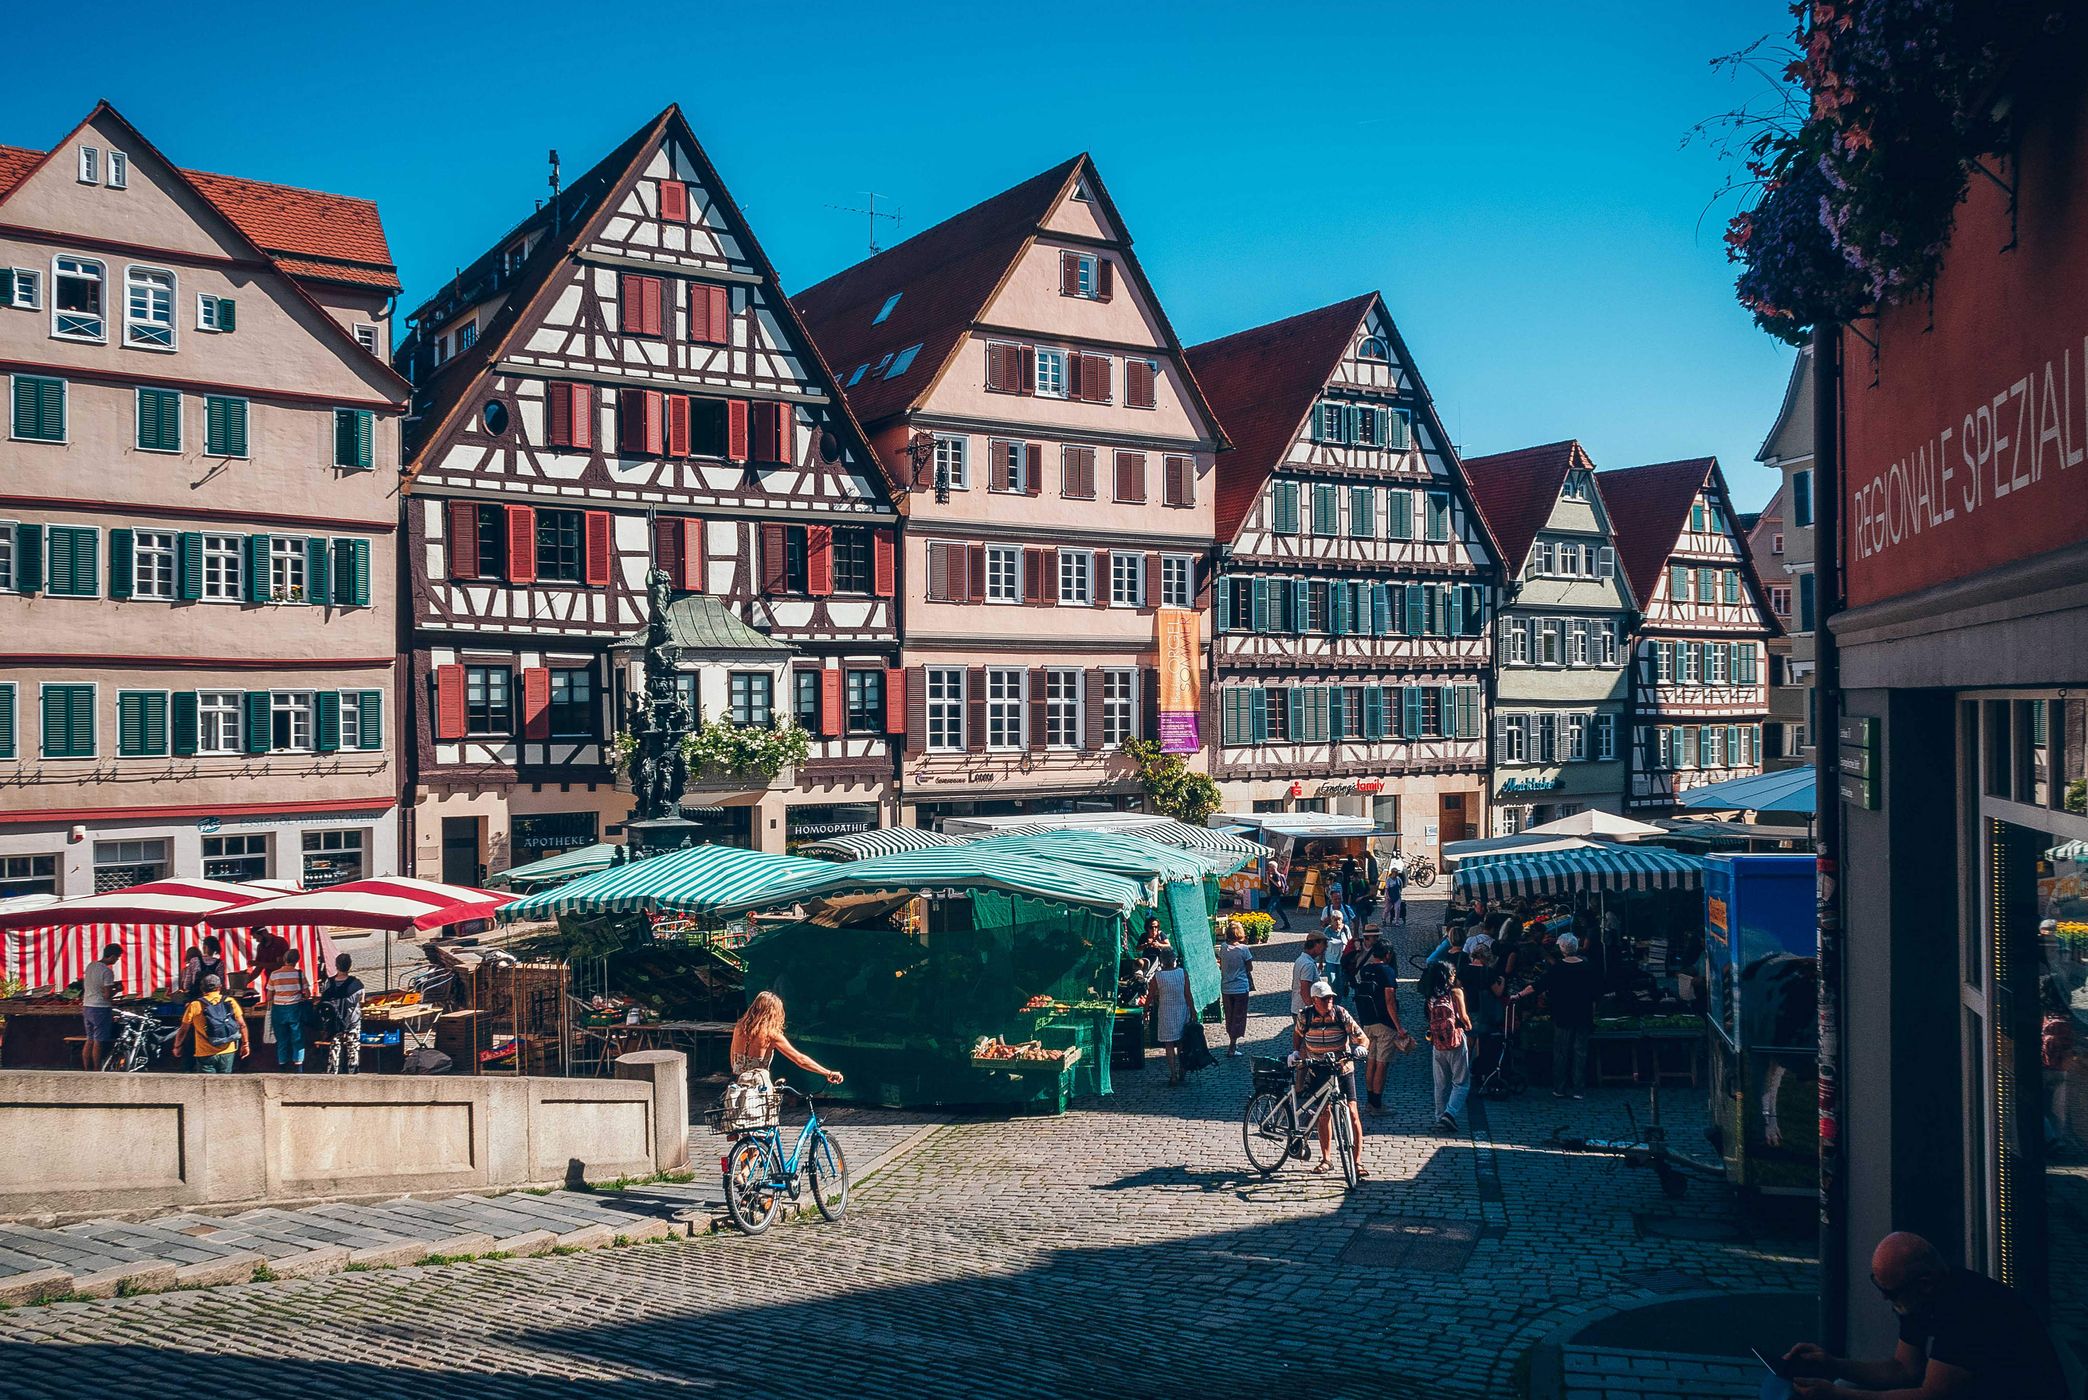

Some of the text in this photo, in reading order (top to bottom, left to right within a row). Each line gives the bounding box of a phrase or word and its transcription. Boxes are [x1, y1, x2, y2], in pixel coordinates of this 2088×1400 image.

[1855, 335, 2088, 562] REGIONALE SPEZIAL
[1167, 618, 1181, 674] ORGEL
[1180, 616, 1192, 693] SOMMER
[1356, 779, 1385, 793] family
[239, 817, 272, 828] ESSIG
[300, 814, 346, 825] WHISKY
[350, 813, 379, 823] WEIN
[524, 836, 585, 847] APOTHEKE
